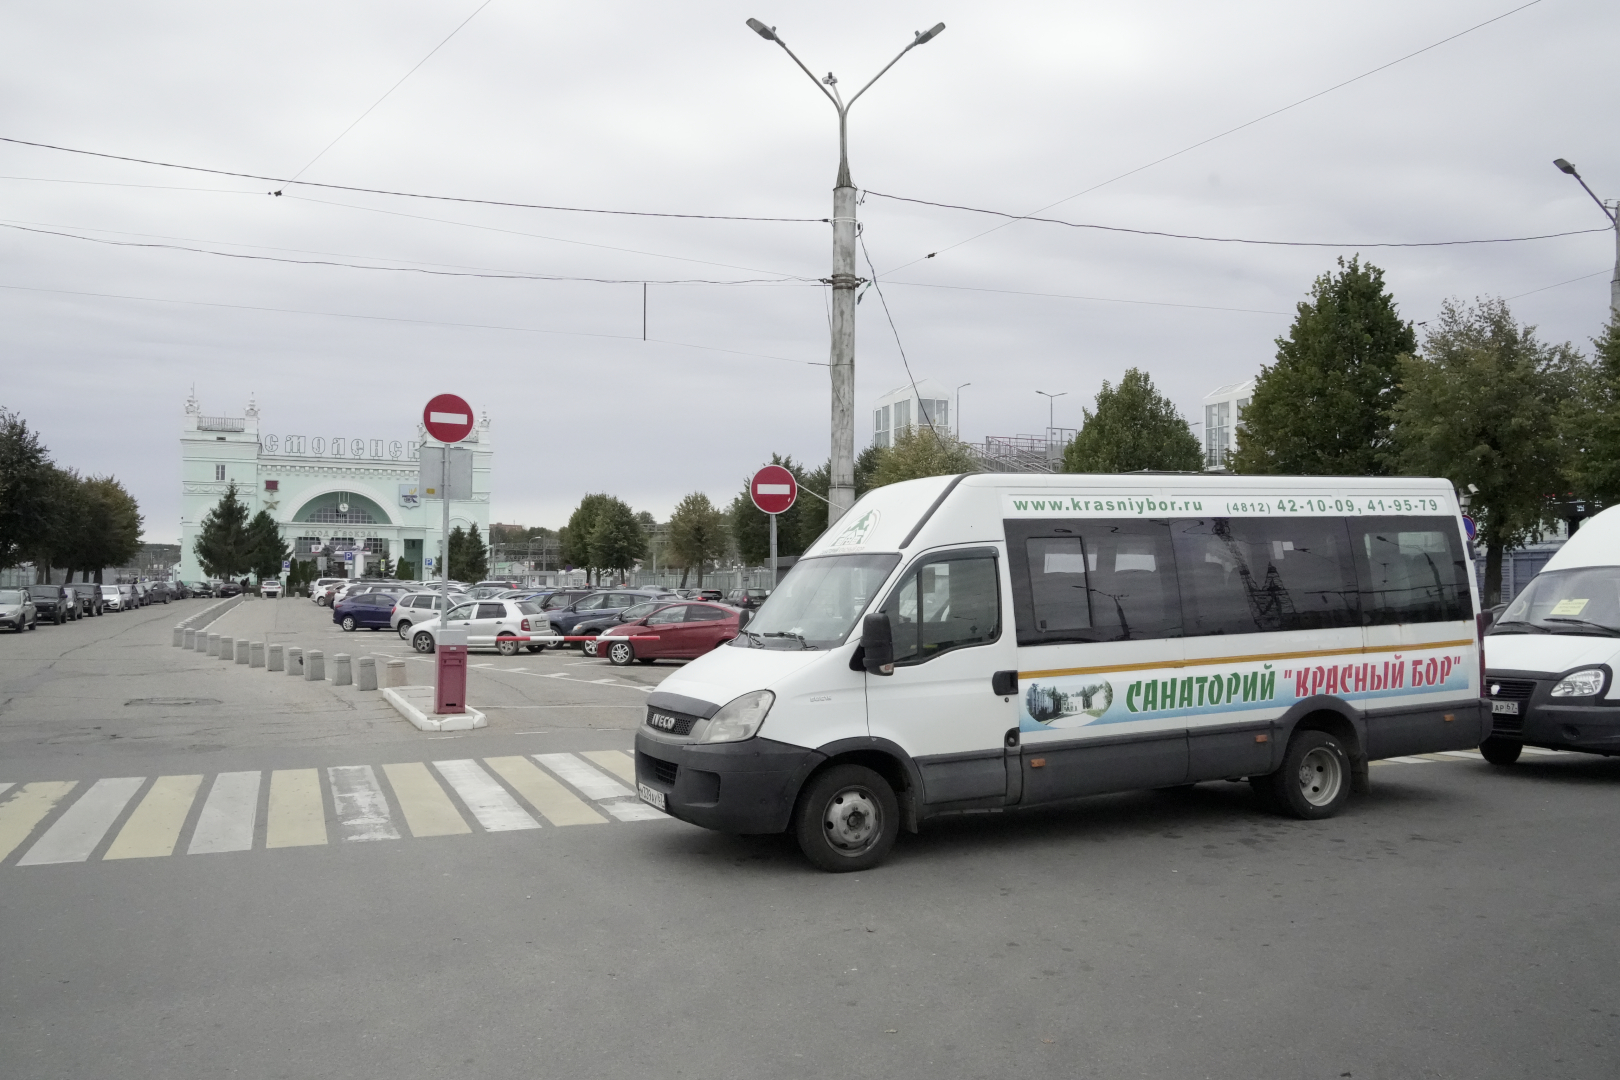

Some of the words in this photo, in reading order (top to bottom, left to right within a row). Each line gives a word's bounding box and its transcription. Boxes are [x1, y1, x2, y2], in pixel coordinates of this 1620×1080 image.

[1013, 498, 1203, 514] www.krasniybor.ru
[1226, 502, 1271, 514] (4812)
[1277, 499, 1362, 514] 42-10-09,
[1367, 499, 1438, 512] 41-95-79
[342, 530, 378, 538] ВОКЗАЛ
[1126, 663, 1276, 712] САНАТОРИЙ
[1284, 654, 1405, 697] "КРАСНЫЙ
[1411, 656, 1461, 688] БОР"
[652, 713, 675, 729] IVECO
